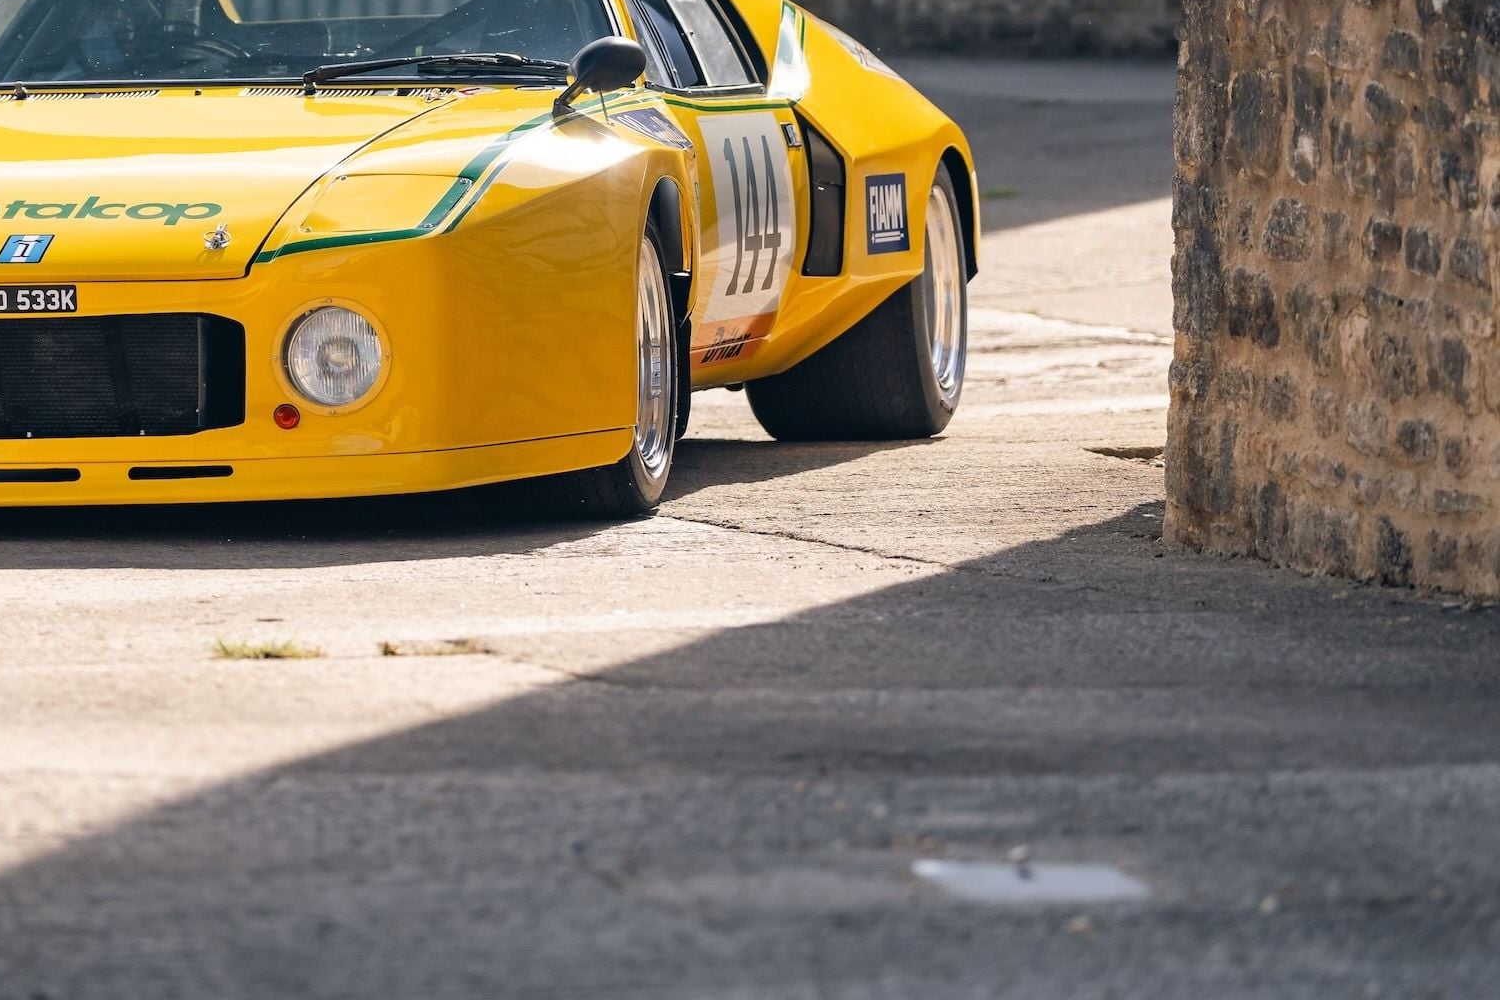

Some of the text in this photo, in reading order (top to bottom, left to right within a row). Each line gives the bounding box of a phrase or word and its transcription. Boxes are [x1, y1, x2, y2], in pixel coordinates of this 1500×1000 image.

[723, 134, 782, 297] 144
[869, 183, 904, 232] FIAMM
[16, 289, 75, 311] 533K
